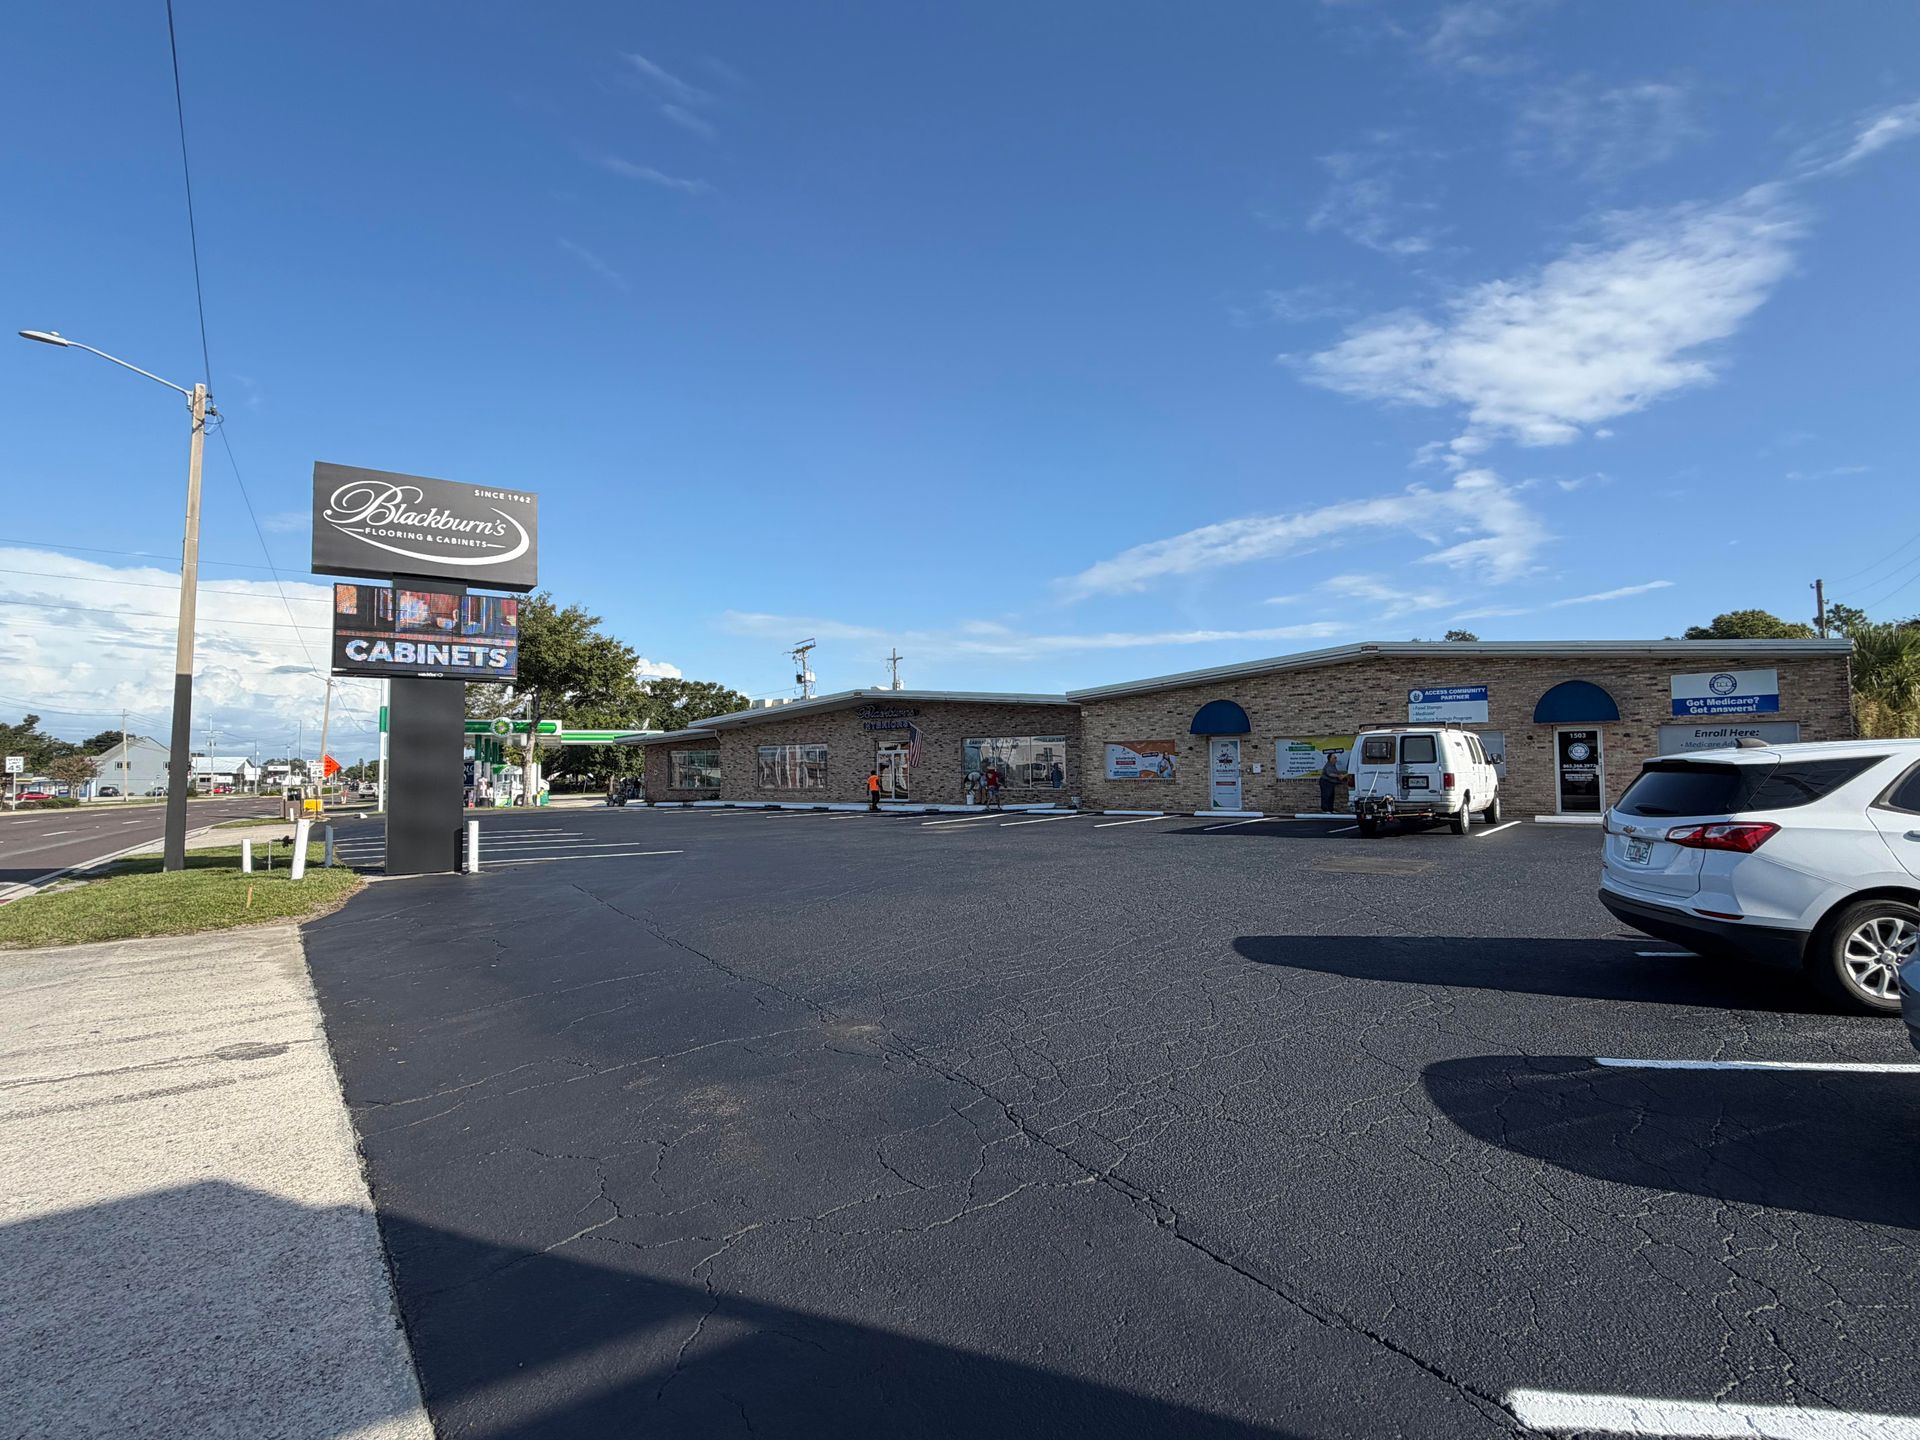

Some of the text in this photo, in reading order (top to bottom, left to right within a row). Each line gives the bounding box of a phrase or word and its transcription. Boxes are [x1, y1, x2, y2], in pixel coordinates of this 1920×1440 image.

[474, 489, 531, 504] SINCE 1962
[323, 480, 507, 537] Blackburn's
[365, 527, 487, 548] FLOORING & CABINETS
[345, 639, 508, 668] CABINETS
[1448, 687, 1486, 695] COMMUNITY
[1686, 696, 1760, 707] Got Medicare?
[1689, 704, 1757, 714] Get answers!
[1694, 728, 1760, 738] Enroll Here:
